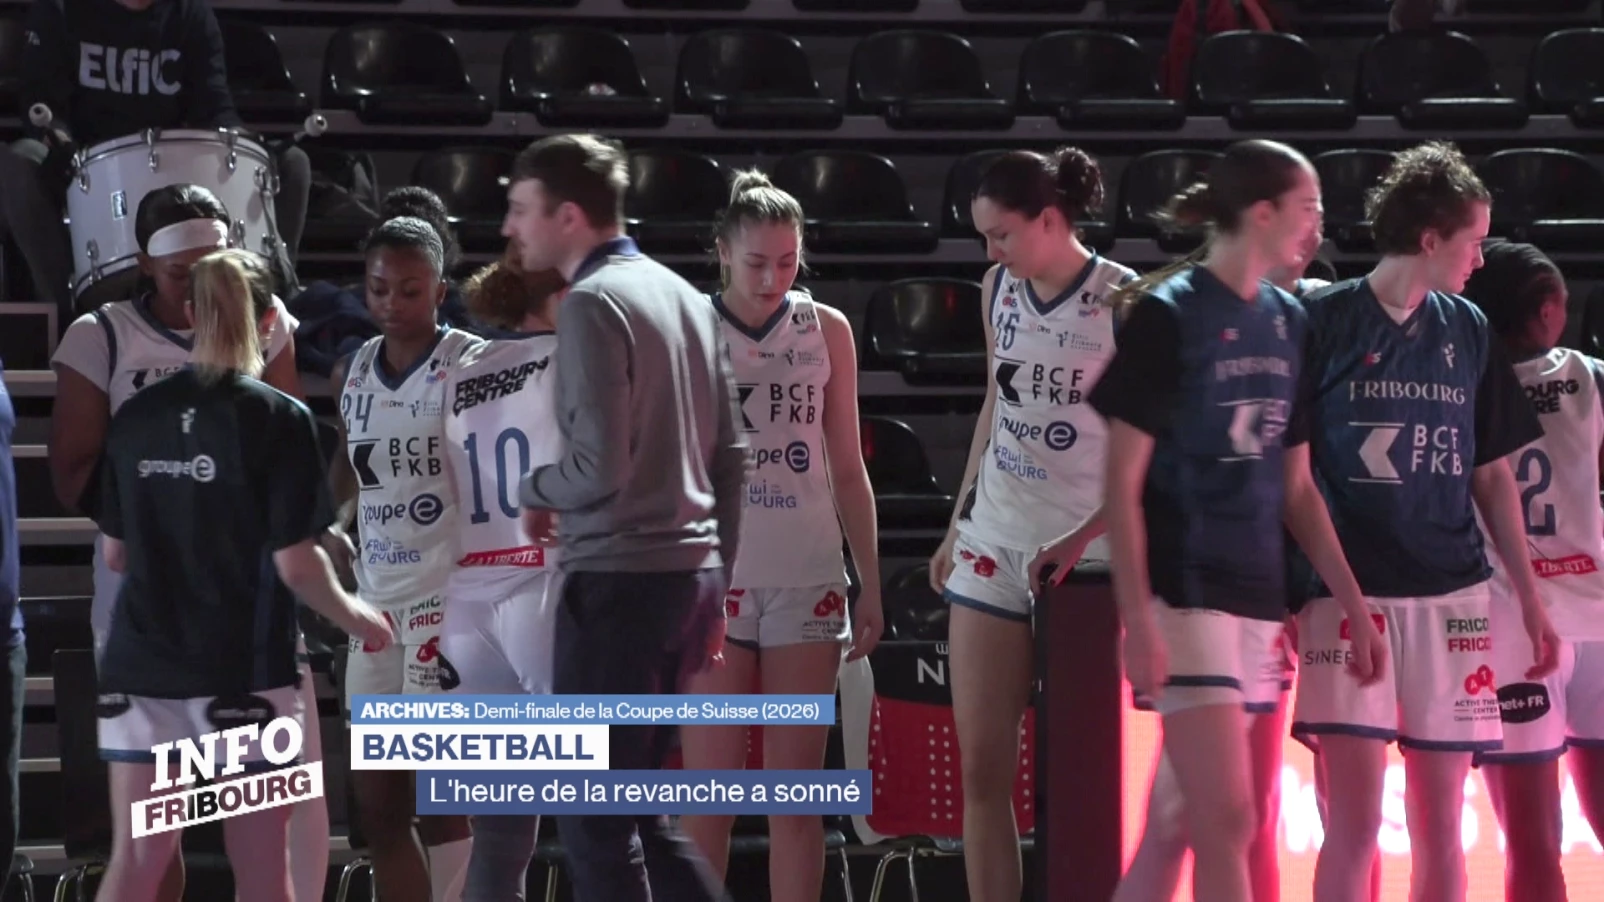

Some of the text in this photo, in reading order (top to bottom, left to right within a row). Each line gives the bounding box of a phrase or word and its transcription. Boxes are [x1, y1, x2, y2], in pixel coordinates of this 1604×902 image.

[455, 356, 549, 398] FRIBOURG
[1033, 364, 1083, 387] BCF
[453, 378, 526, 417] CENTRE
[770, 383, 815, 402] BCF
[1032, 383, 1081, 405] FKB
[1350, 380, 1465, 404] FRIBOURG
[1524, 379, 1579, 399] OURG
[342, 393, 374, 434] 24
[770, 403, 815, 425] FKB
[389, 437, 439, 457] BCF
[1414, 424, 1458, 450] BCF
[391, 458, 442, 478] FKB
[1411, 450, 1463, 476] FKB
[463, 427, 530, 525] 10
[409, 612, 444, 631] FRIC
[1528, 695, 1544, 708] FR
